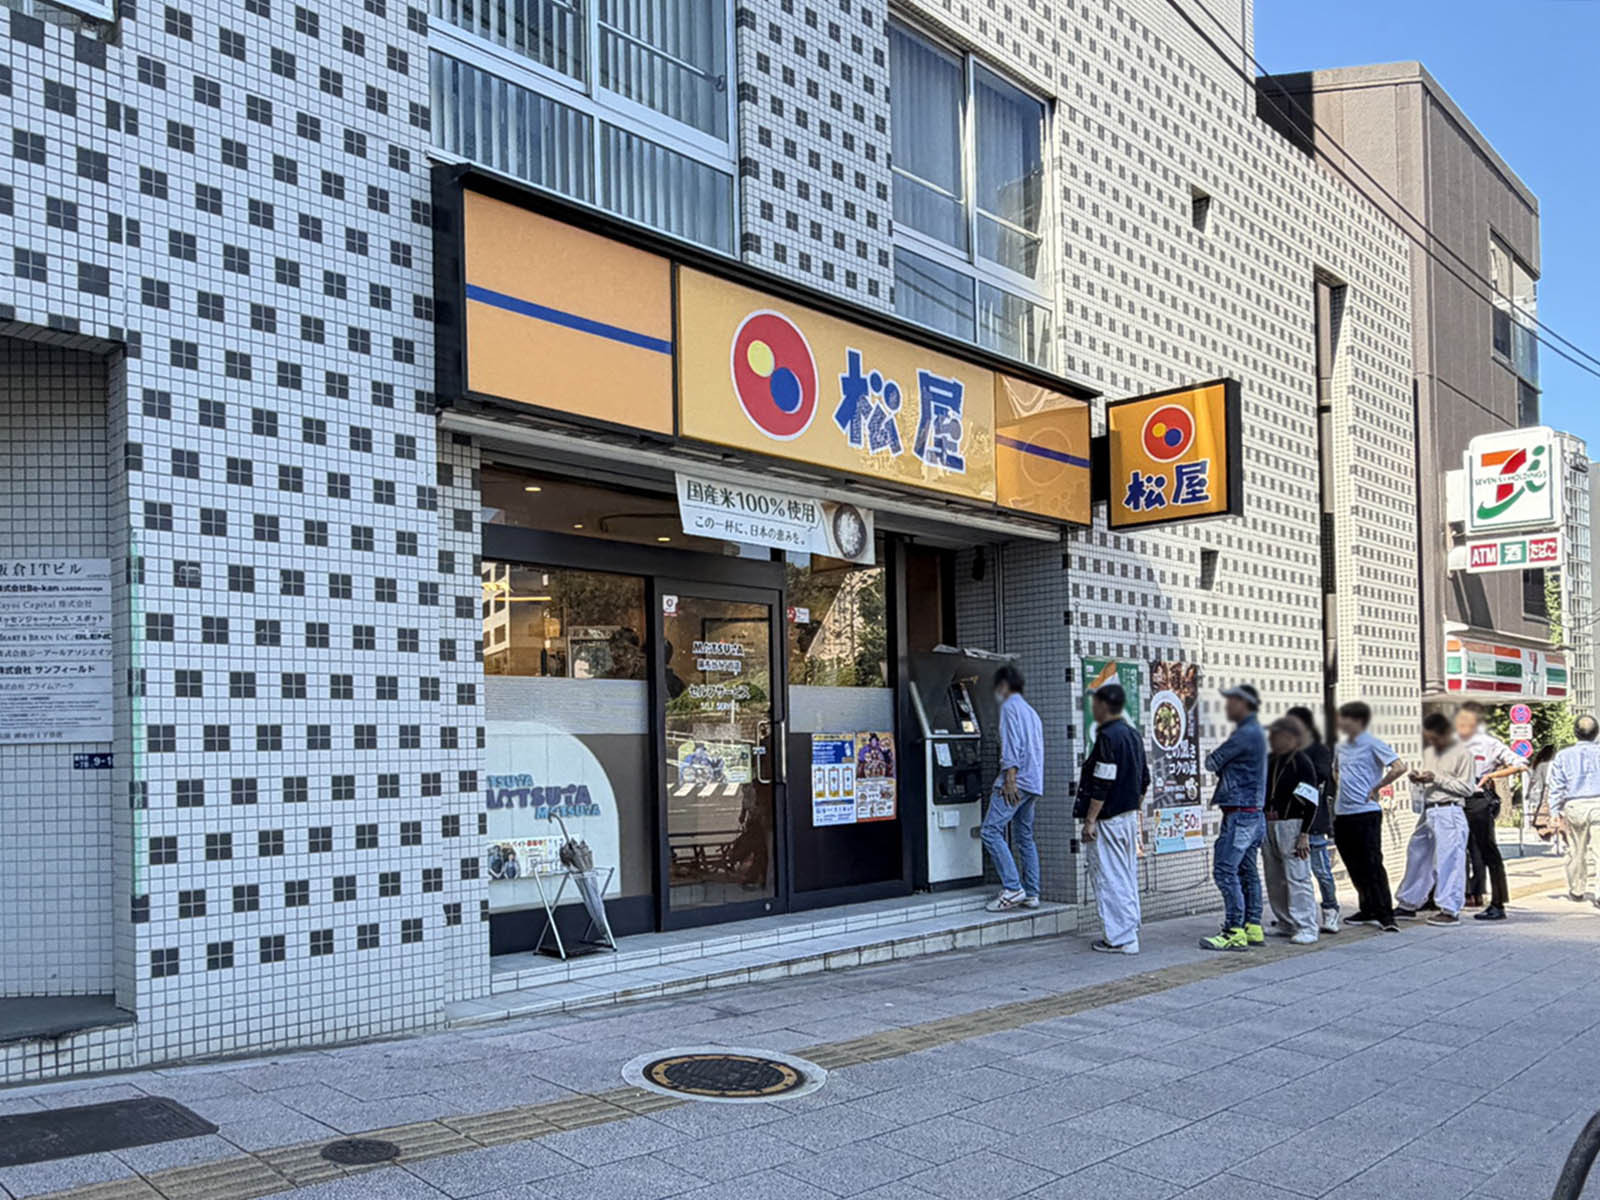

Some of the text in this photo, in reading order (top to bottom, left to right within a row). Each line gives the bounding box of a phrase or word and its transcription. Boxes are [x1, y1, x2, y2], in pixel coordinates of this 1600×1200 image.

[832, 347, 967, 475] 松屋
[1122, 459, 1210, 511] 松屋
[687, 480, 815, 524] 国産米100%使用
[1471, 548, 1498, 565] ATM
[35, 664, 96, 674] サンフィールド
[689, 684, 751, 699] セルフサービス
